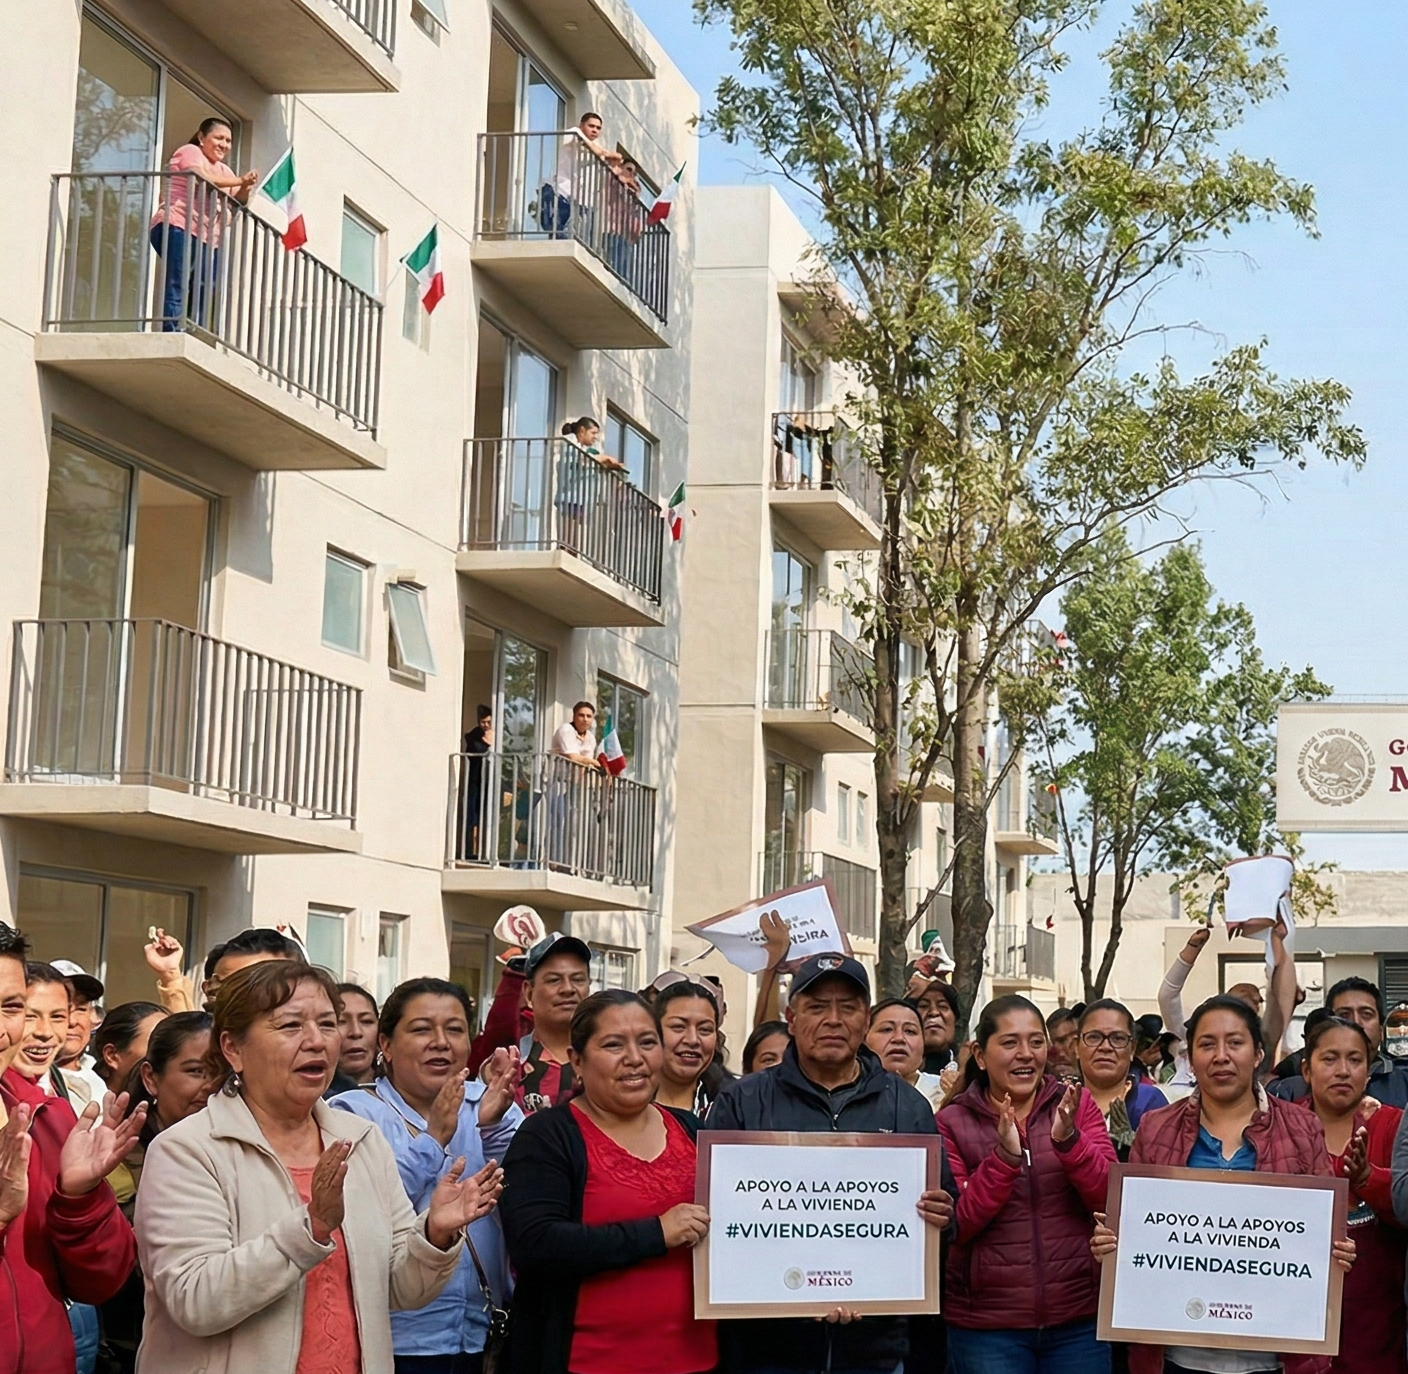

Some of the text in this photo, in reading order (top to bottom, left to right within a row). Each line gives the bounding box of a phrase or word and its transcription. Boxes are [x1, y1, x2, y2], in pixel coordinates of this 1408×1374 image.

[734, 1180, 900, 1194] APOYO A LA APOYOS
[761, 1198, 877, 1211] A LA VIVIENDA
[725, 1222, 910, 1239] #VIVIENDASEGURA
[1143, 1211, 1306, 1234] APOYO A LA APOYOS
[1167, 1230, 1281, 1250] A LA VIVIENDA
[1132, 1252, 1313, 1279] #VIVIENDASEGURA
